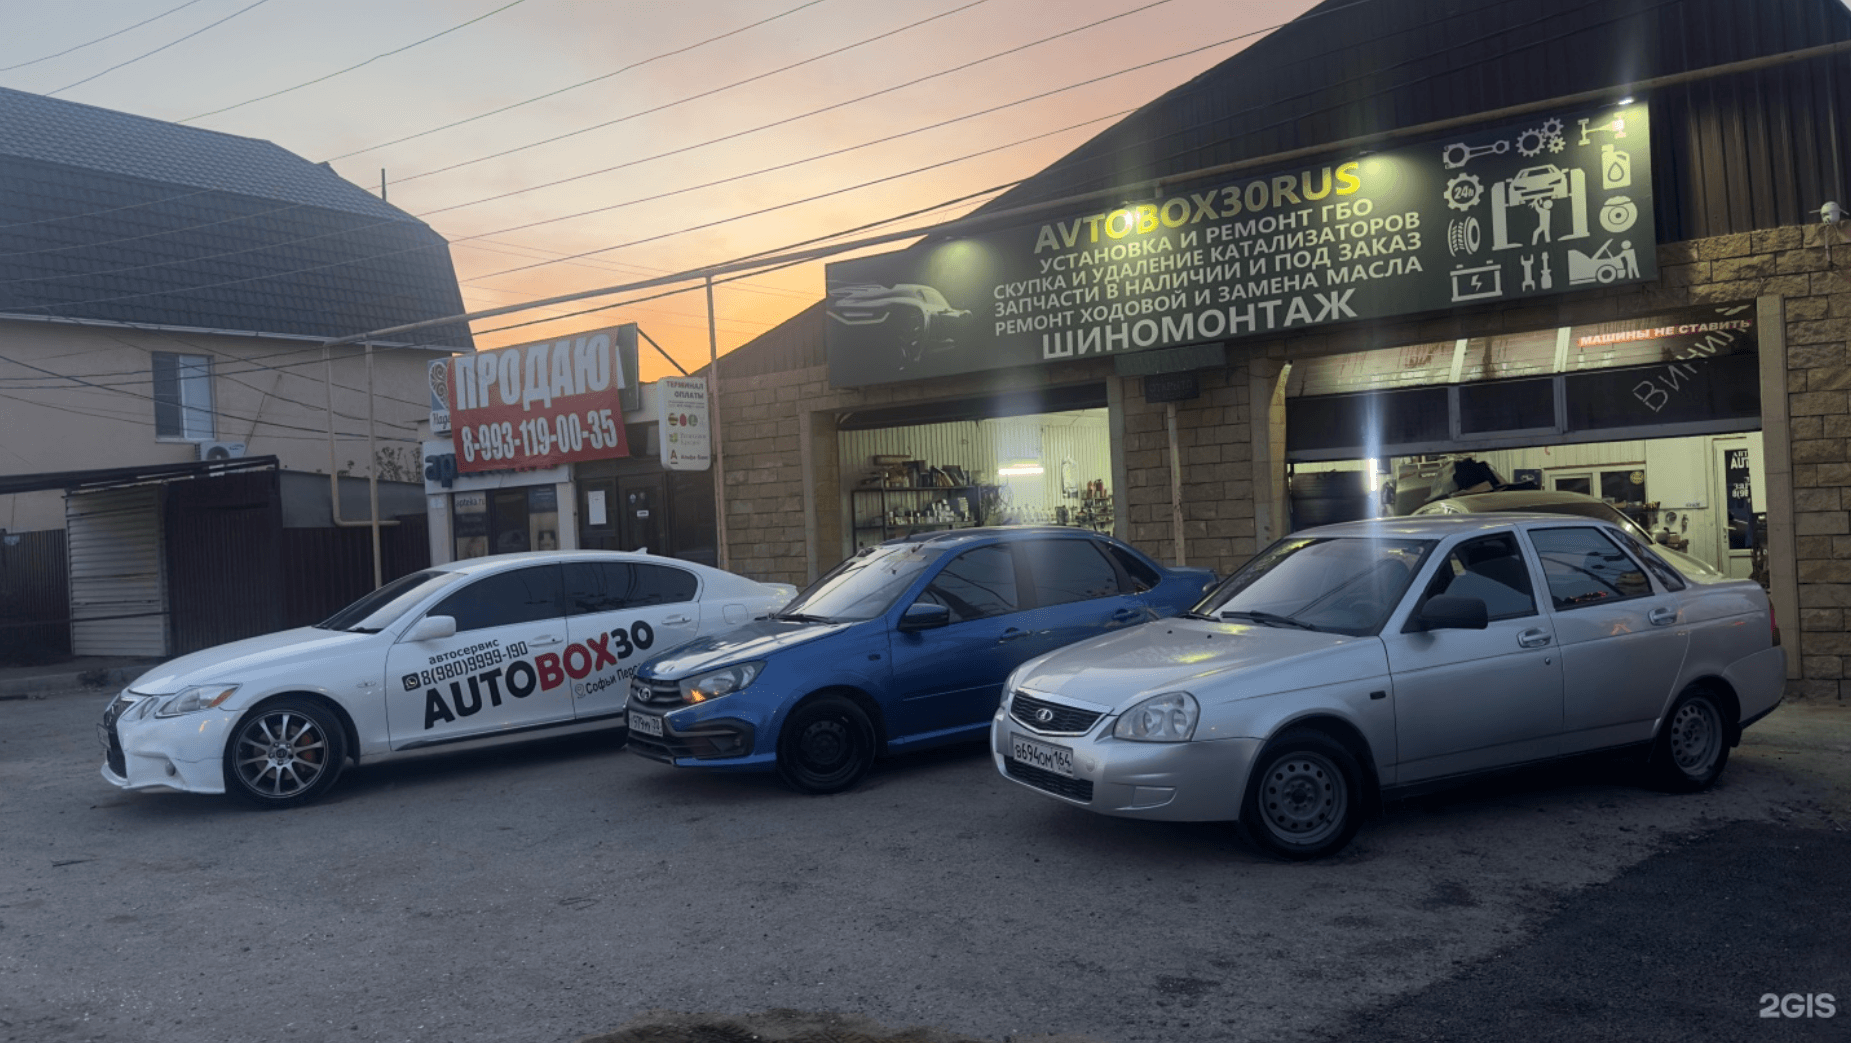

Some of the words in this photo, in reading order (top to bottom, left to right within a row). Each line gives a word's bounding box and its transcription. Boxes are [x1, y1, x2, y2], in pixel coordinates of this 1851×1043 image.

[1034, 162, 1361, 254] AVTOBOX30RUS
[1040, 236, 1173, 274] УСТАНОВКА
[1181, 231, 1197, 249] И
[1206, 208, 1313, 244] РЕМОНТ
[1322, 198, 1373, 223] ГБО
[994, 274, 1066, 299] СКУПКА
[1073, 270, 1086, 287] И
[1092, 250, 1204, 284] УДАЛЕНИЕ
[1211, 211, 1420, 263] КАТАЛИЗАТОРОВ
[995, 286, 1100, 317] ЗАПЧАСТИ
[1107, 284, 1119, 299] В
[1126, 262, 1241, 296] НАЛИЧИИ
[1250, 257, 1266, 276] И
[1275, 247, 1331, 272] ПОД
[1338, 231, 1422, 262] ЗАКАЗ
[995, 310, 1075, 336] РЕМОНТ
[1080, 289, 1187, 323] ХОДОВОЙ
[1195, 288, 1210, 306] И
[1218, 272, 1319, 303] ЗАМЕНА
[1327, 256, 1424, 286] МАСЛА
[1042, 288, 1358, 360] ШИНОМОНТАЖ
[1580, 328, 1650, 346] МАШИНЫ
[1654, 325, 1675, 337] НЕ
[1679, 319, 1751, 334] СТАВИТЬ
[455, 333, 612, 412] ПРОДАЮ
[461, 408, 618, 462] 8-993-119-00-35
[420, 640, 528, 686] 8(980)9999-190
[424, 620, 655, 730] AUTOBOX30
[428, 639, 500, 665] автосервис
[585, 674, 617, 694] Софьи
